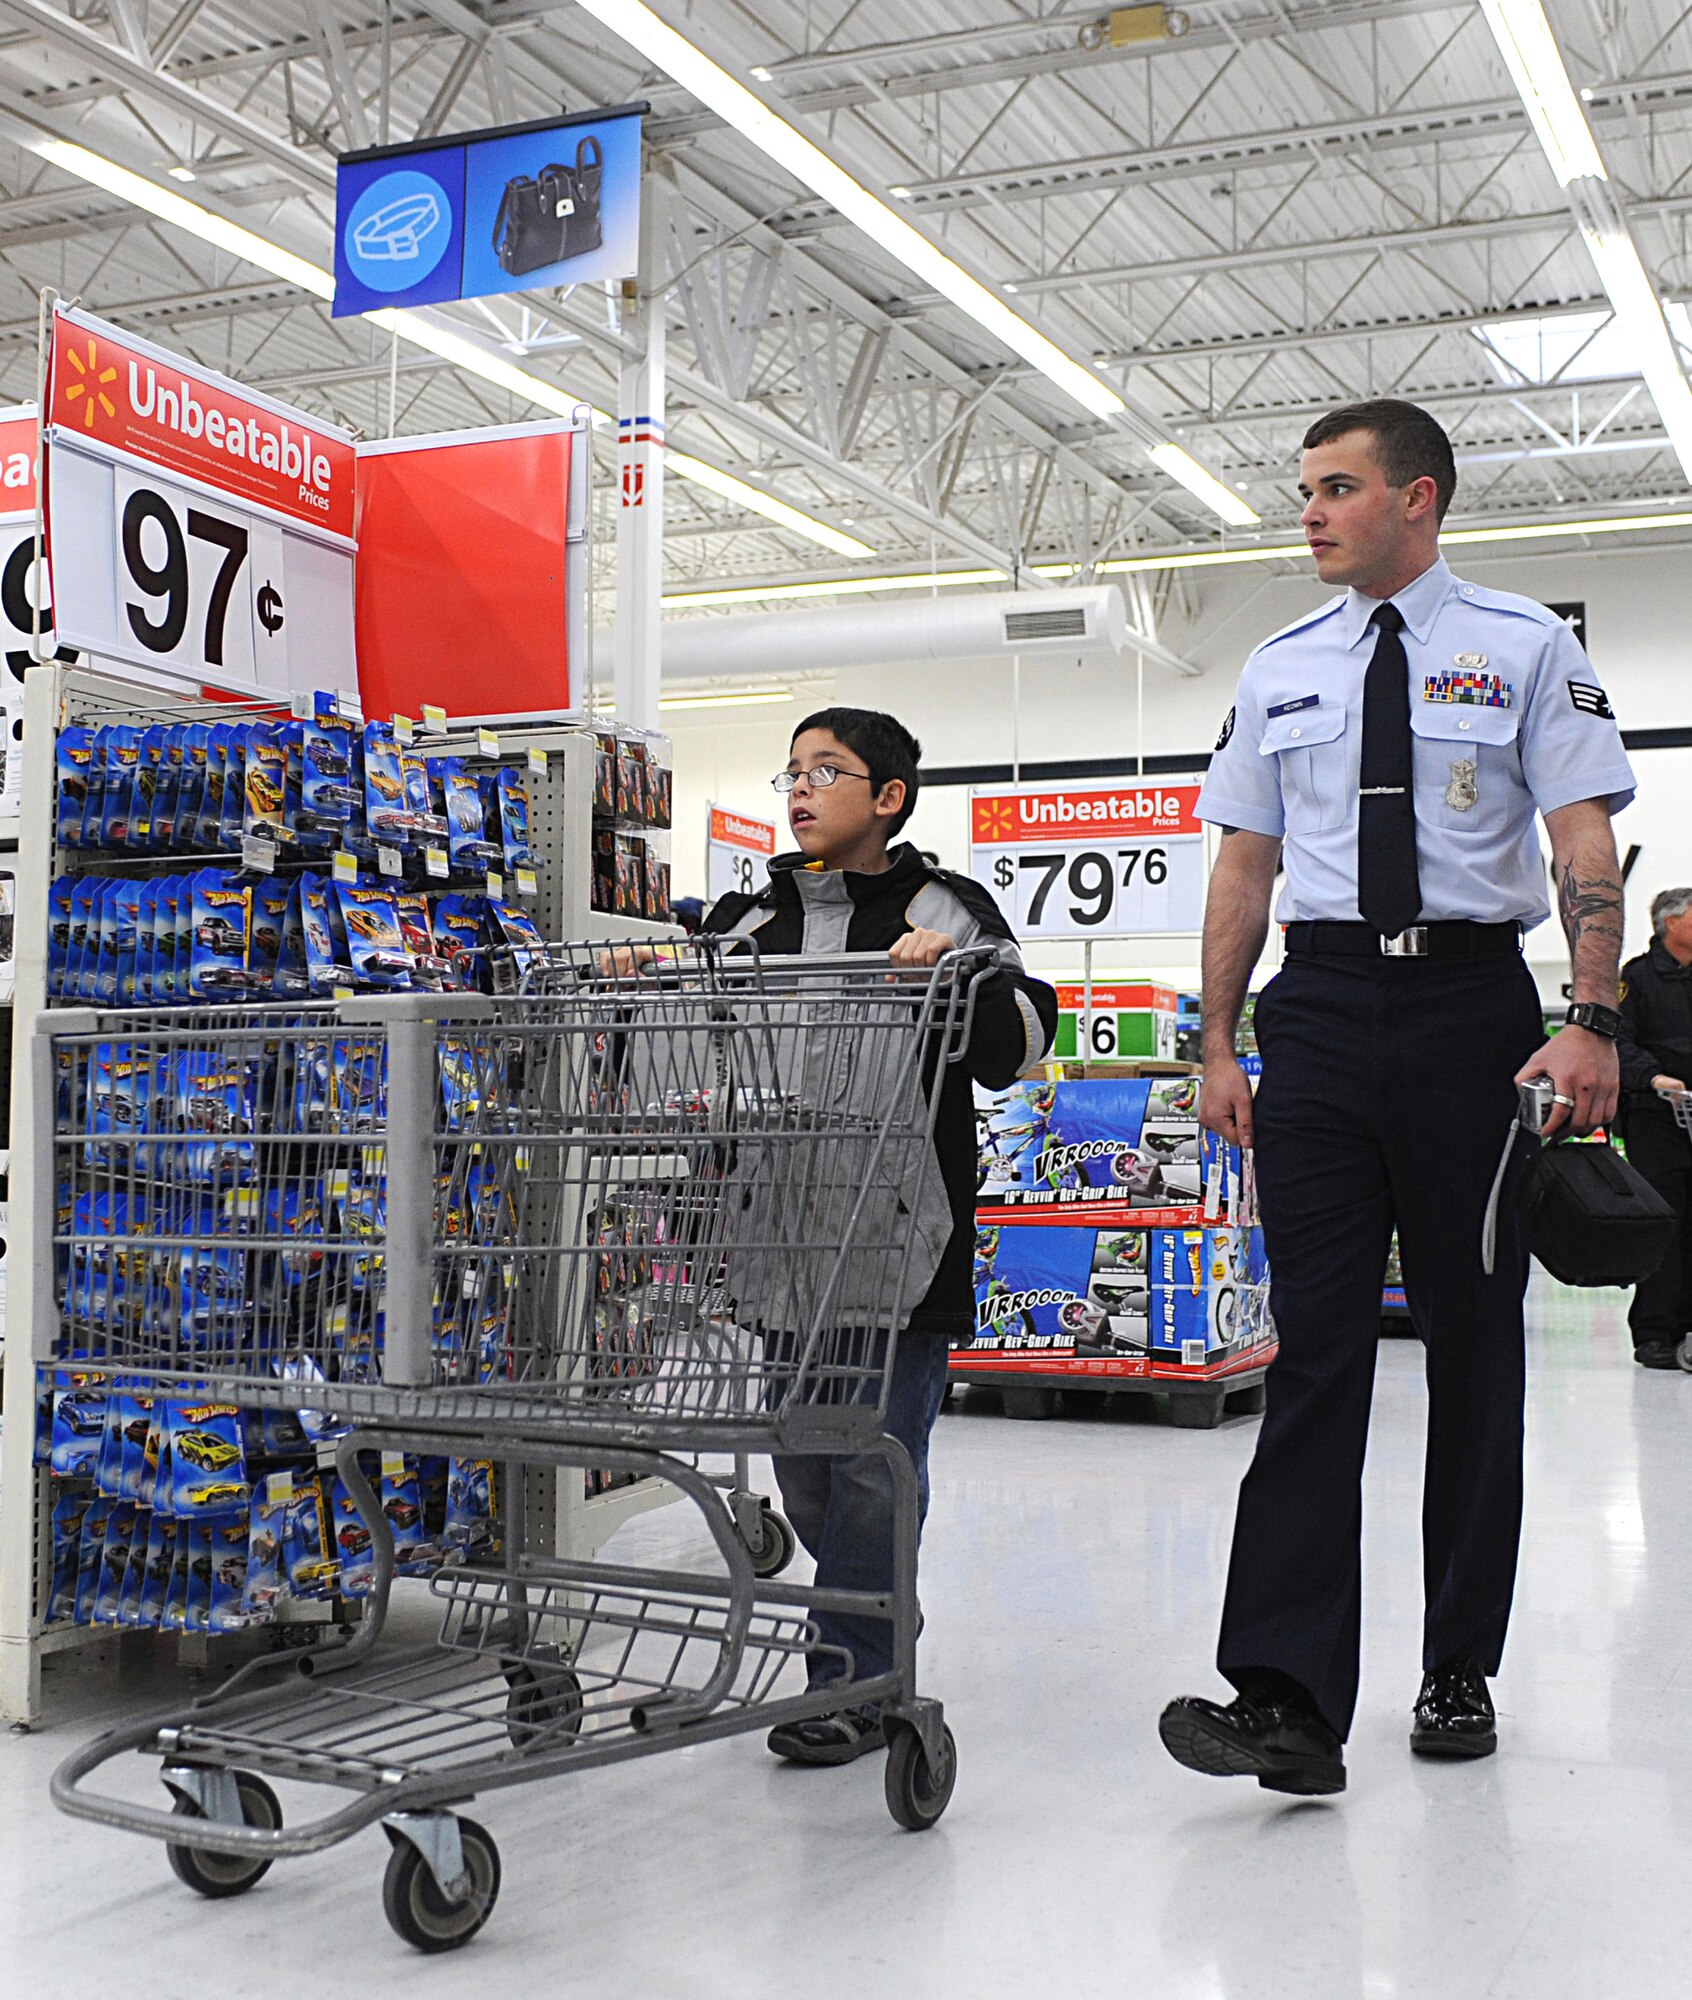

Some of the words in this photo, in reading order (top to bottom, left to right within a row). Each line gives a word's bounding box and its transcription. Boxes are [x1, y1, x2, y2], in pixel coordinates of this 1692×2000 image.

[128, 361, 331, 492] Unbeatable
[298, 485, 330, 511] Prices
[1019, 791, 1180, 824] Unbeatable
[1153, 816, 1180, 827] Prices
[725, 816, 772, 844] Unbeatable
